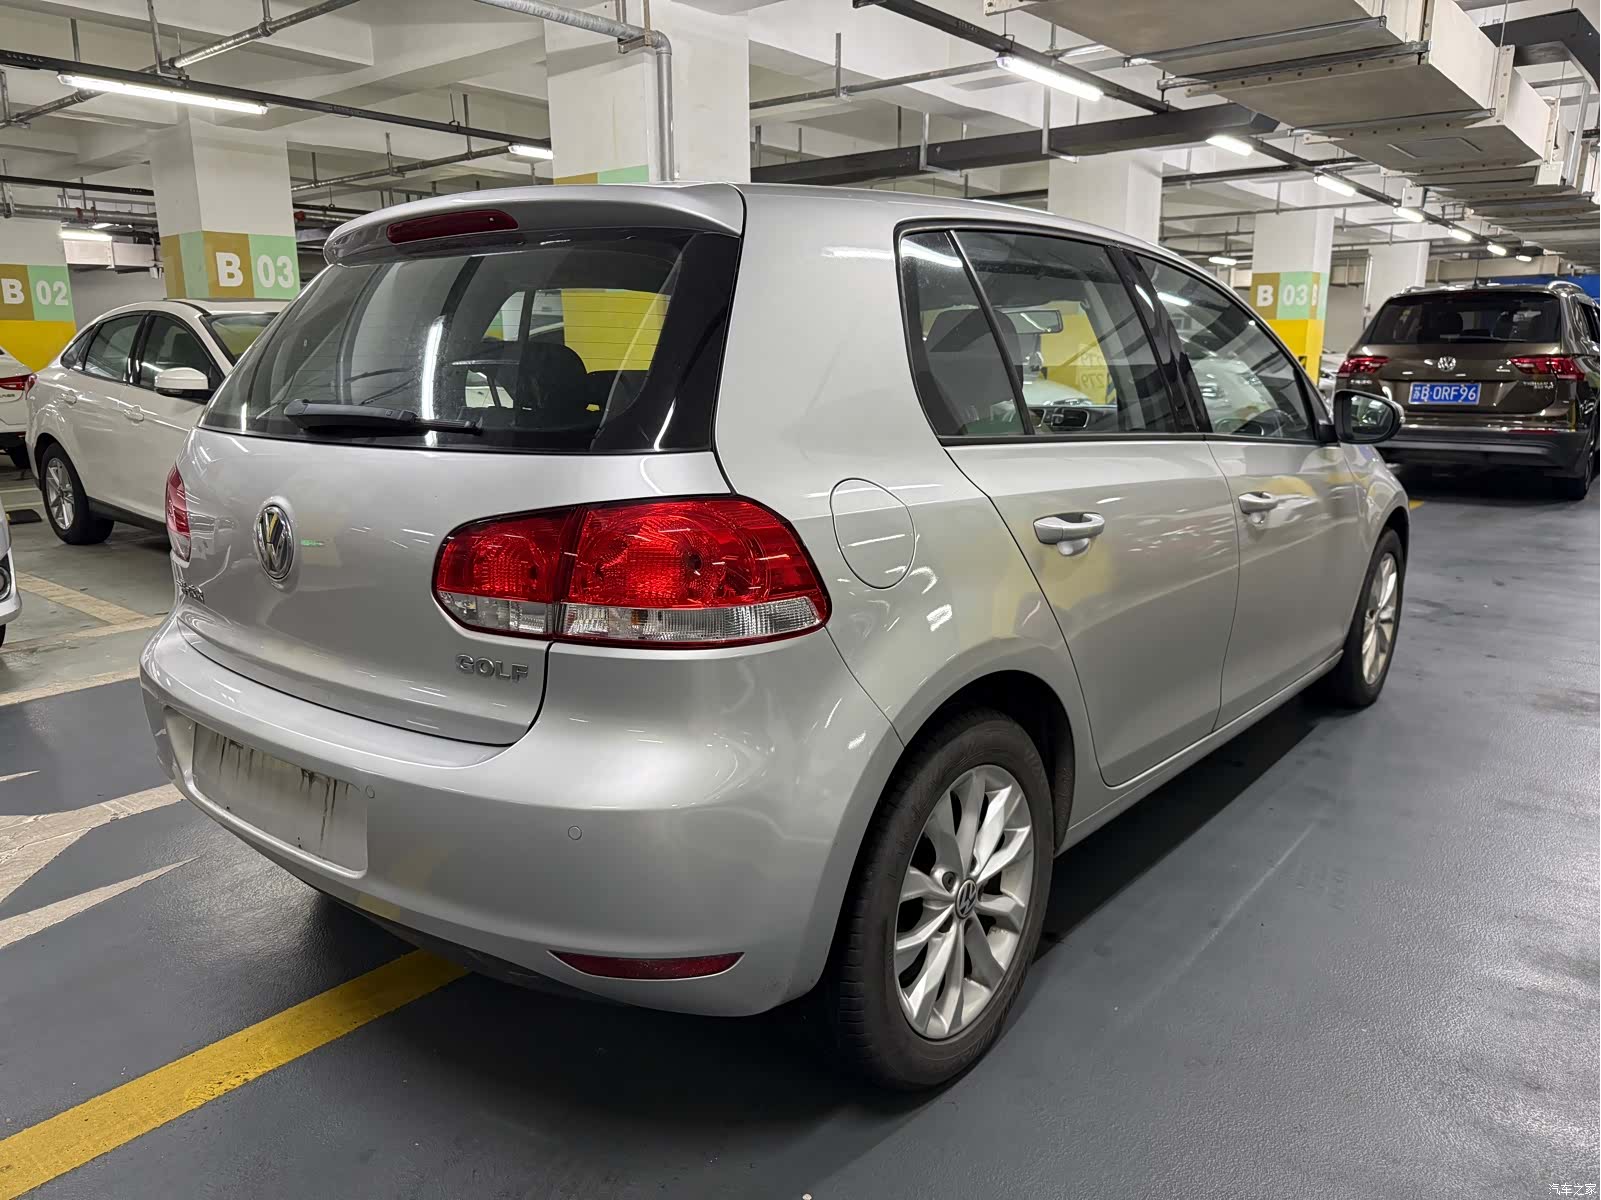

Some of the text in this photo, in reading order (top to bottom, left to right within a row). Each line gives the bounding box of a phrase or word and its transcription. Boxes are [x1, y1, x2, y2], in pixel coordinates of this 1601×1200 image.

[215, 251, 294, 288] B 03
[1, 278, 69, 306] B 02
[1256, 284, 1274, 307] B
[1282, 284, 1308, 306] 03
[456, 653, 529, 681] GOLF
